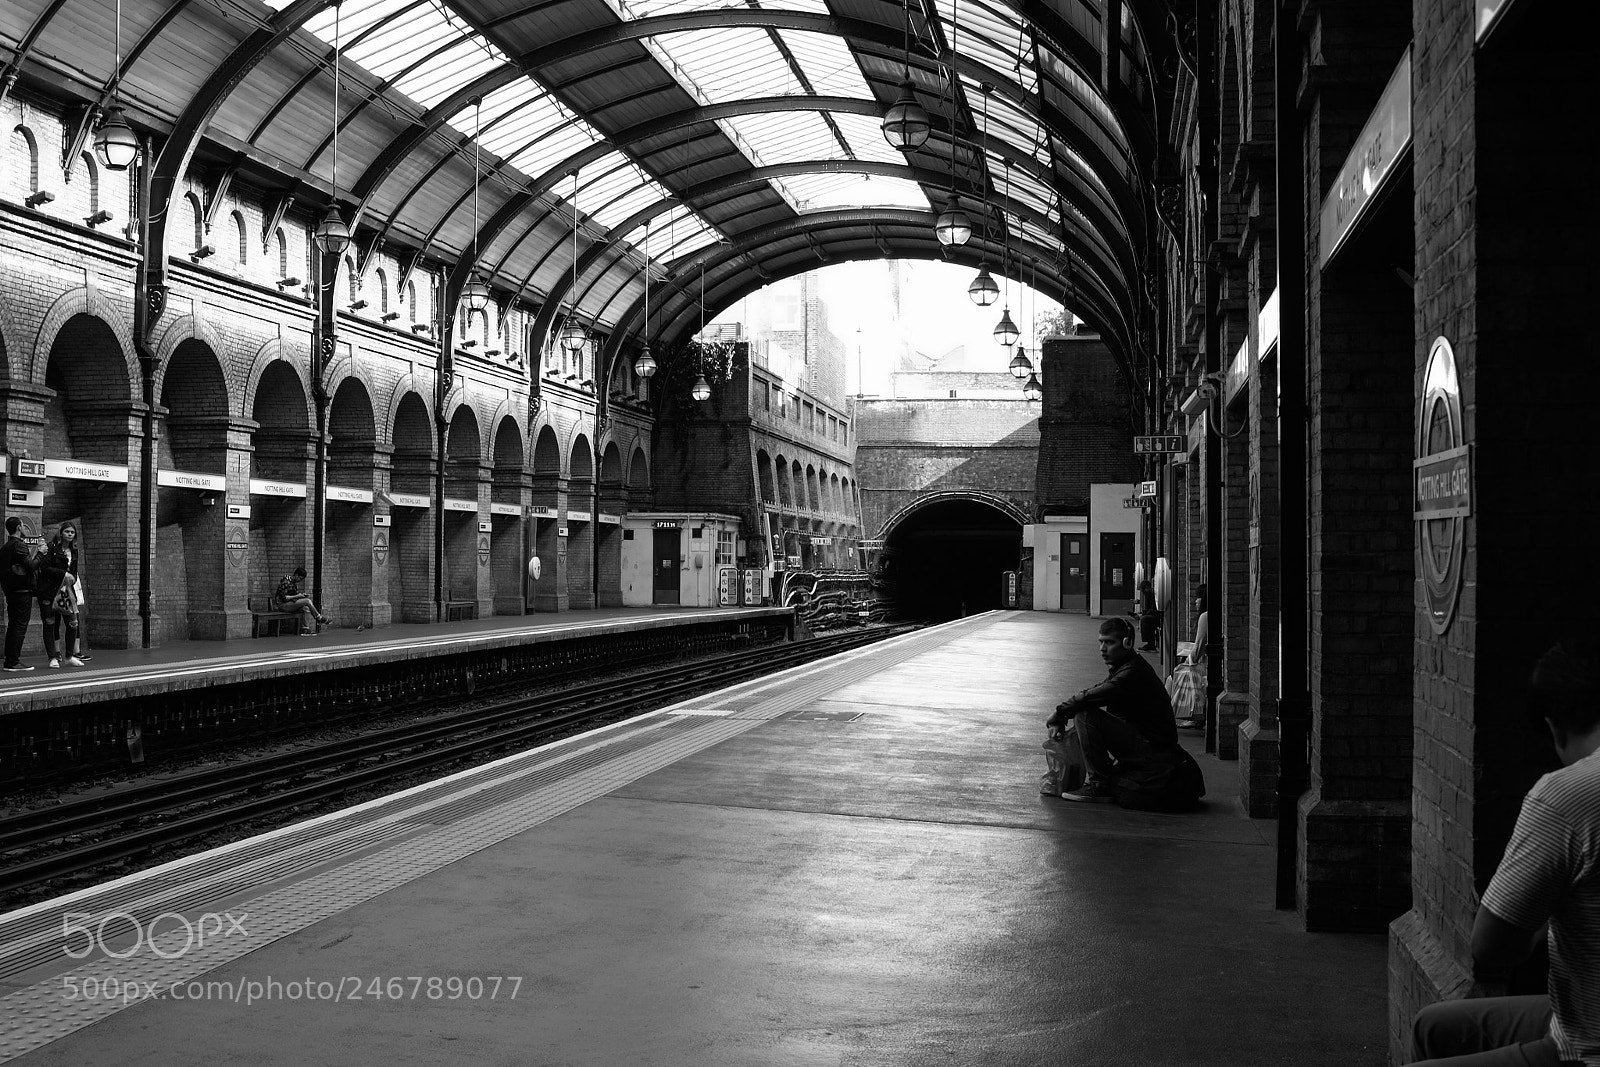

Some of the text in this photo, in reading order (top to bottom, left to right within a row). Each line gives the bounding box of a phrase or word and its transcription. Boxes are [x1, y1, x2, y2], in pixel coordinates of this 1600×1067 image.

[65, 466, 109, 478] NOTTING HILL GATE
[1439, 471, 1451, 498] HILL
[1451, 468, 1467, 496] GATE
